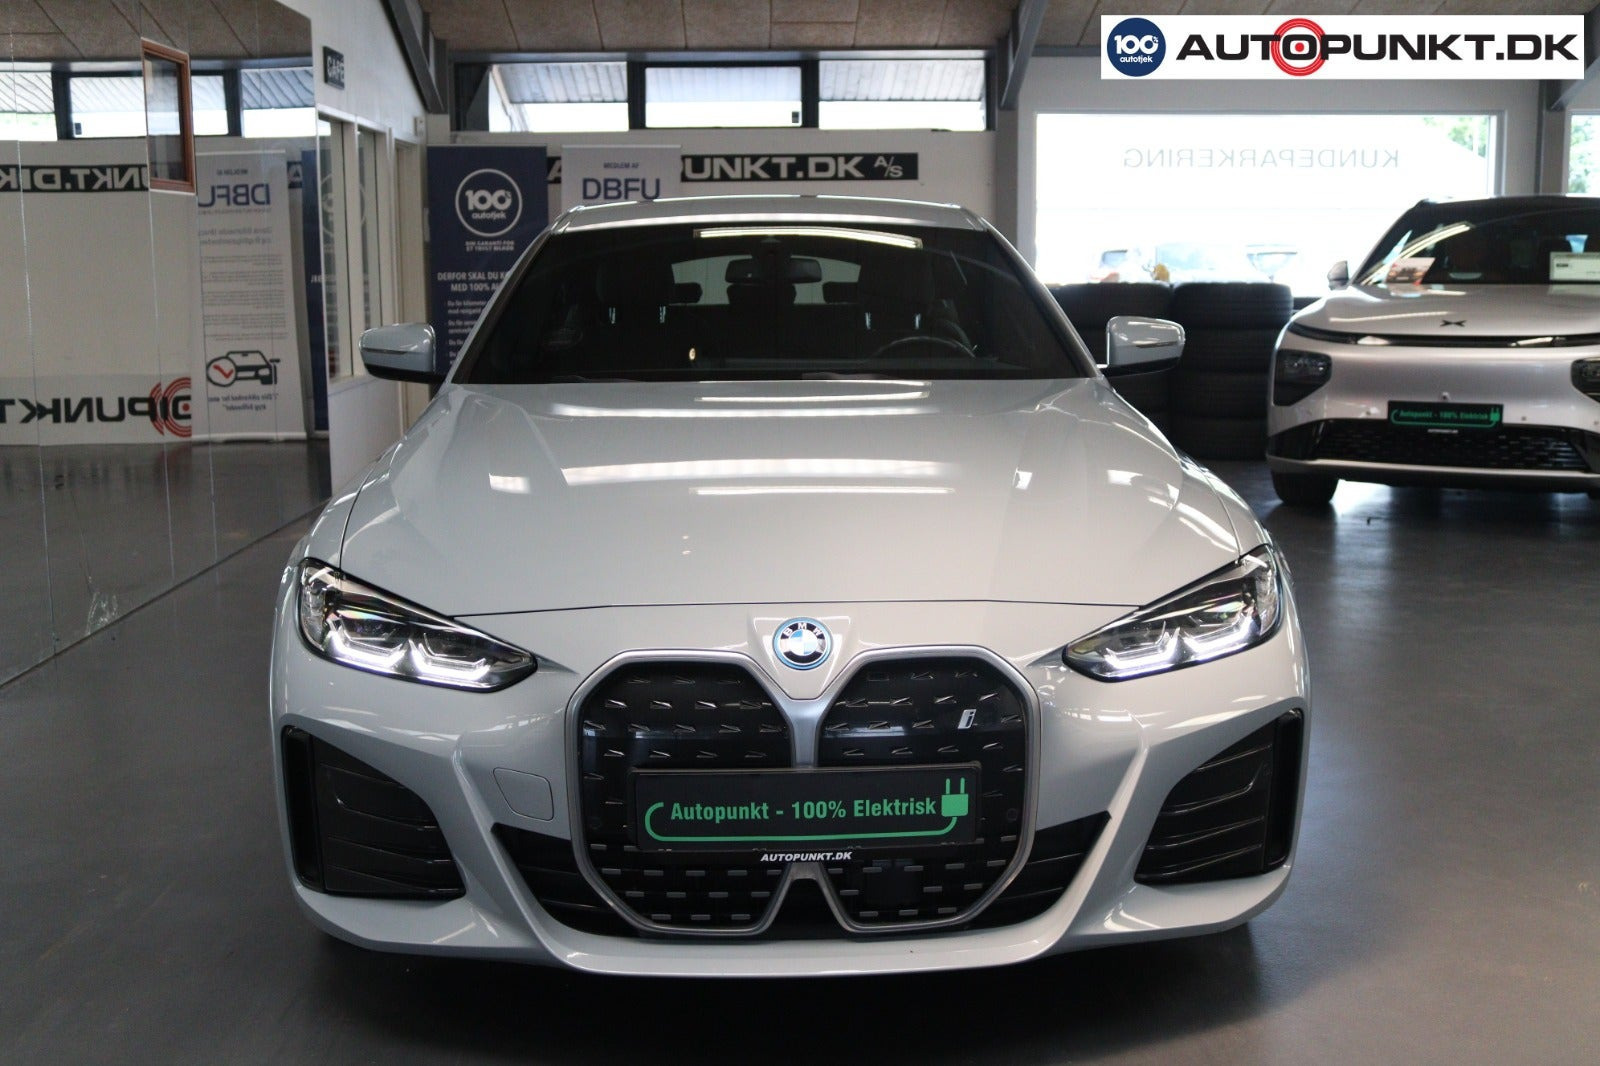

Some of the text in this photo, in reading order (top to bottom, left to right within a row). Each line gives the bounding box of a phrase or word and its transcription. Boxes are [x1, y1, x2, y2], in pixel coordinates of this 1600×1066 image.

[682, 156, 865, 180] UNKT.DK
[582, 177, 661, 200] DBFU
[437, 272, 466, 281] DERFOR
[468, 272, 485, 281] SKAL
[487, 271, 499, 280] DU
[451, 283, 468, 292] MED
[470, 283, 490, 292] 100%
[783, 621, 824, 637] BMW
[670, 801, 769, 824] Autopunkt
[791, 800, 847, 820] 100%
[853, 797, 936, 818] Elektrisk
[760, 851, 852, 863] AUTOPUNKT.DK
